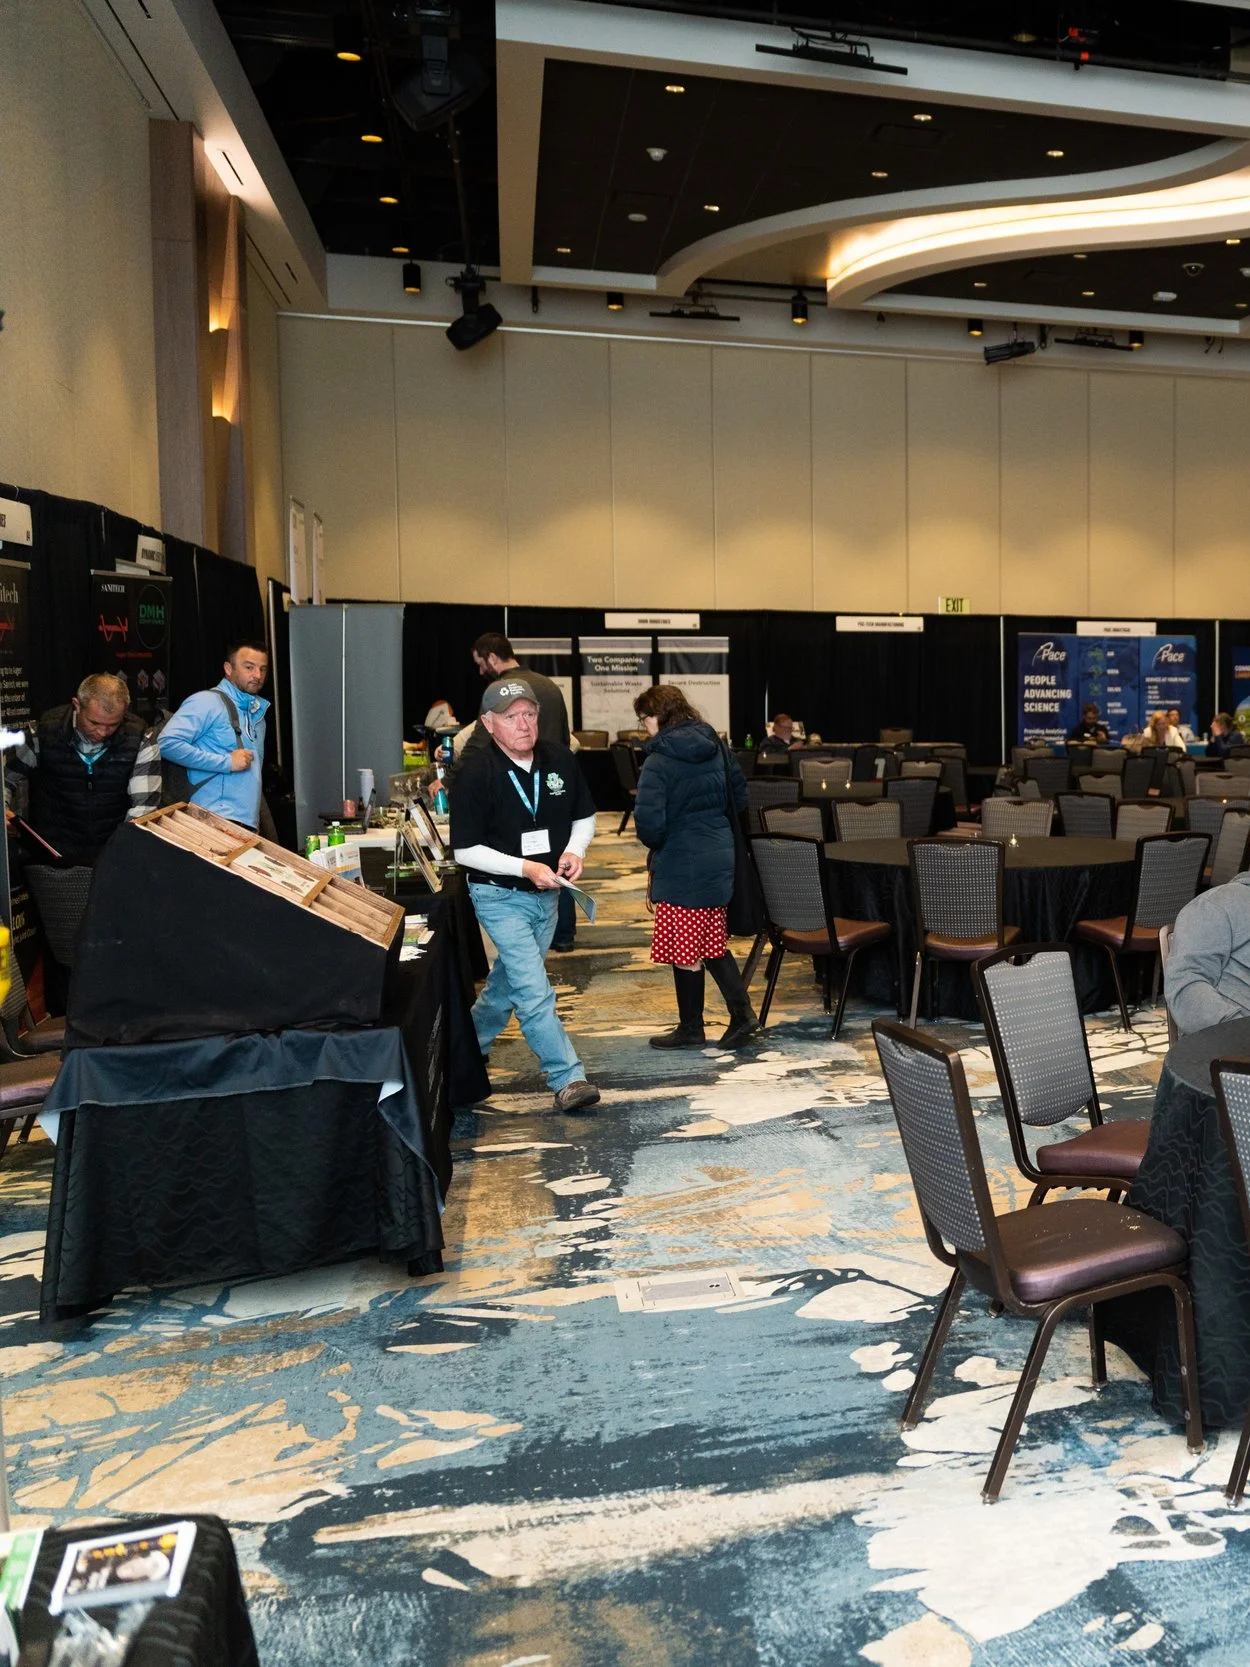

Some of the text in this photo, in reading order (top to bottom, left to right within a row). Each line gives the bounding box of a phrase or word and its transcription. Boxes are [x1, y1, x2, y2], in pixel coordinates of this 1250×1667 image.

[945, 598, 963, 612] EXIT
[139, 605, 165, 619] DMH
[604, 656, 645, 664] Companies,
[594, 664, 638, 672] One Mission
[1024, 675, 1057, 685] PEOPLE
[1024, 689, 1072, 699] ADVANCING
[1024, 703, 1060, 712] SCIENCE
